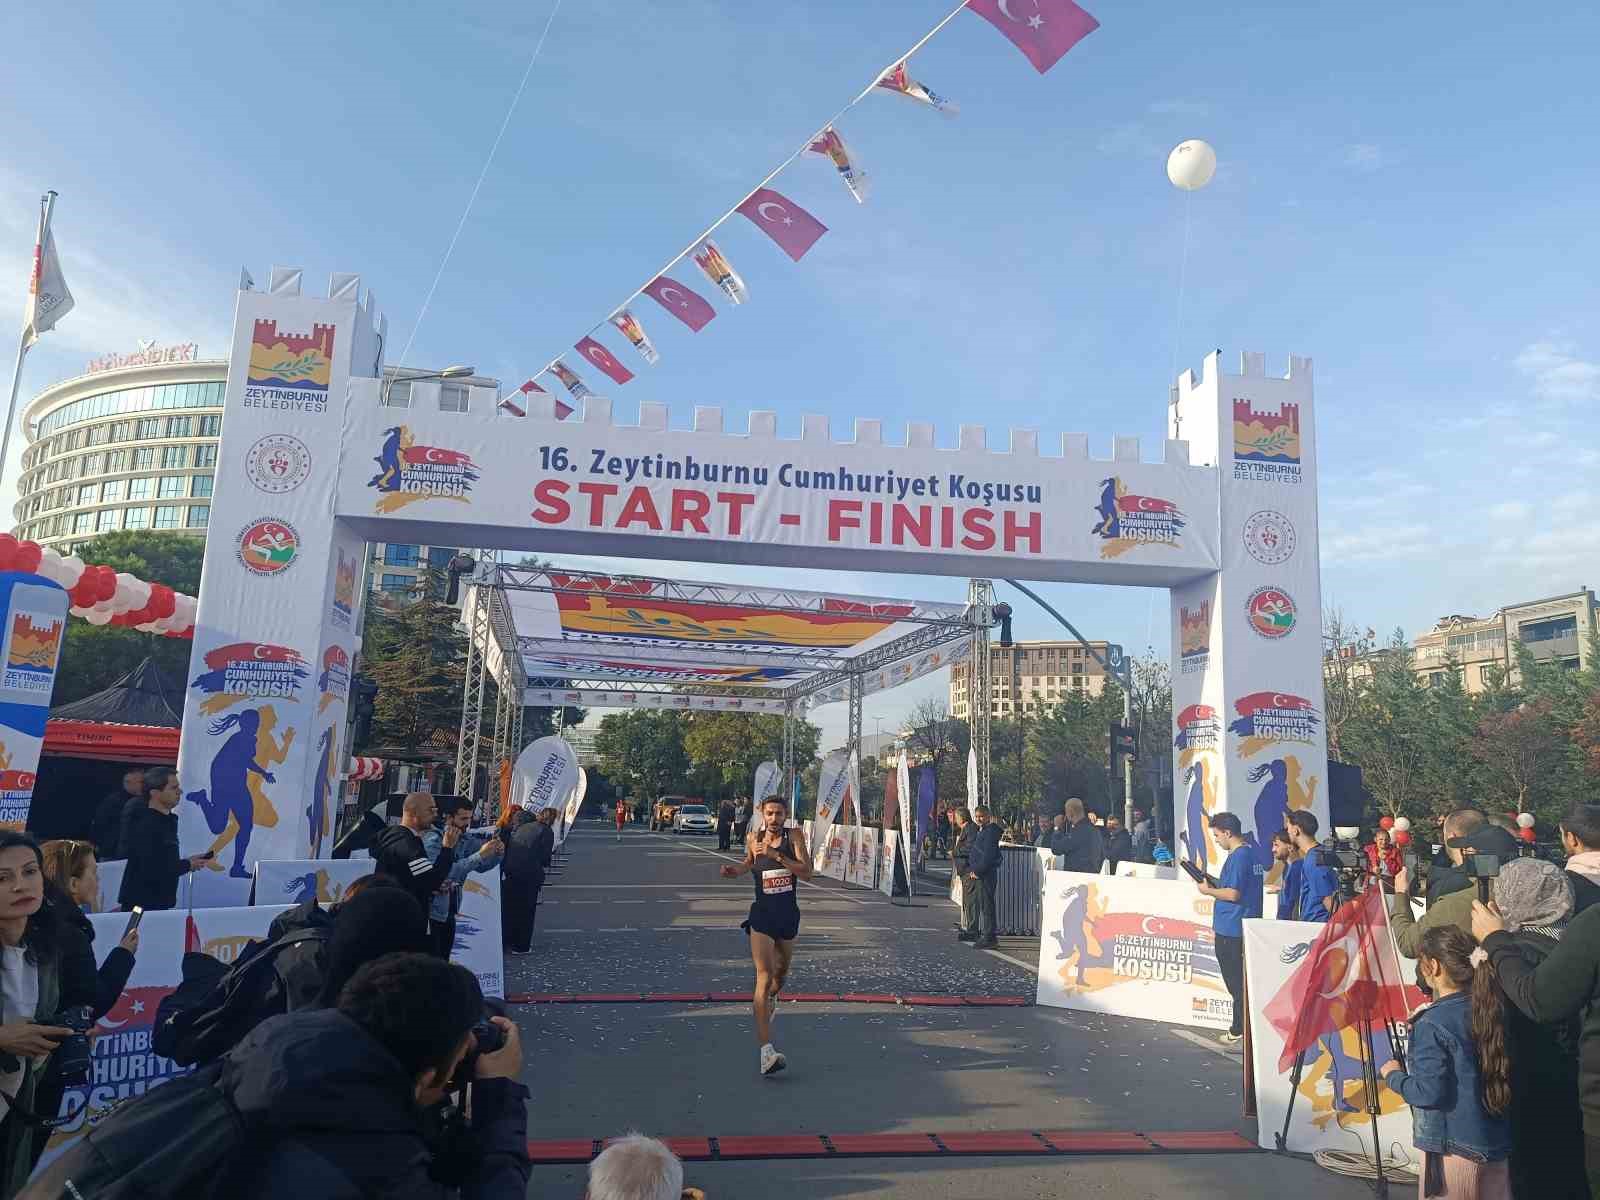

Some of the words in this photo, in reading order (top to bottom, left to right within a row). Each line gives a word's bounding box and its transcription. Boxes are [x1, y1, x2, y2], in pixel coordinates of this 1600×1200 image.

[539, 446, 577, 473] 16.
[589, 449, 768, 486] Zeytinburnu
[778, 463, 940, 501] Cumhuriyet
[949, 475, 1042, 506] Koşusu
[530, 479, 756, 536] START
[779, 513, 801, 526] -
[827, 499, 1043, 554] FINISH
[1113, 957, 1193, 985] KOŞUSU
